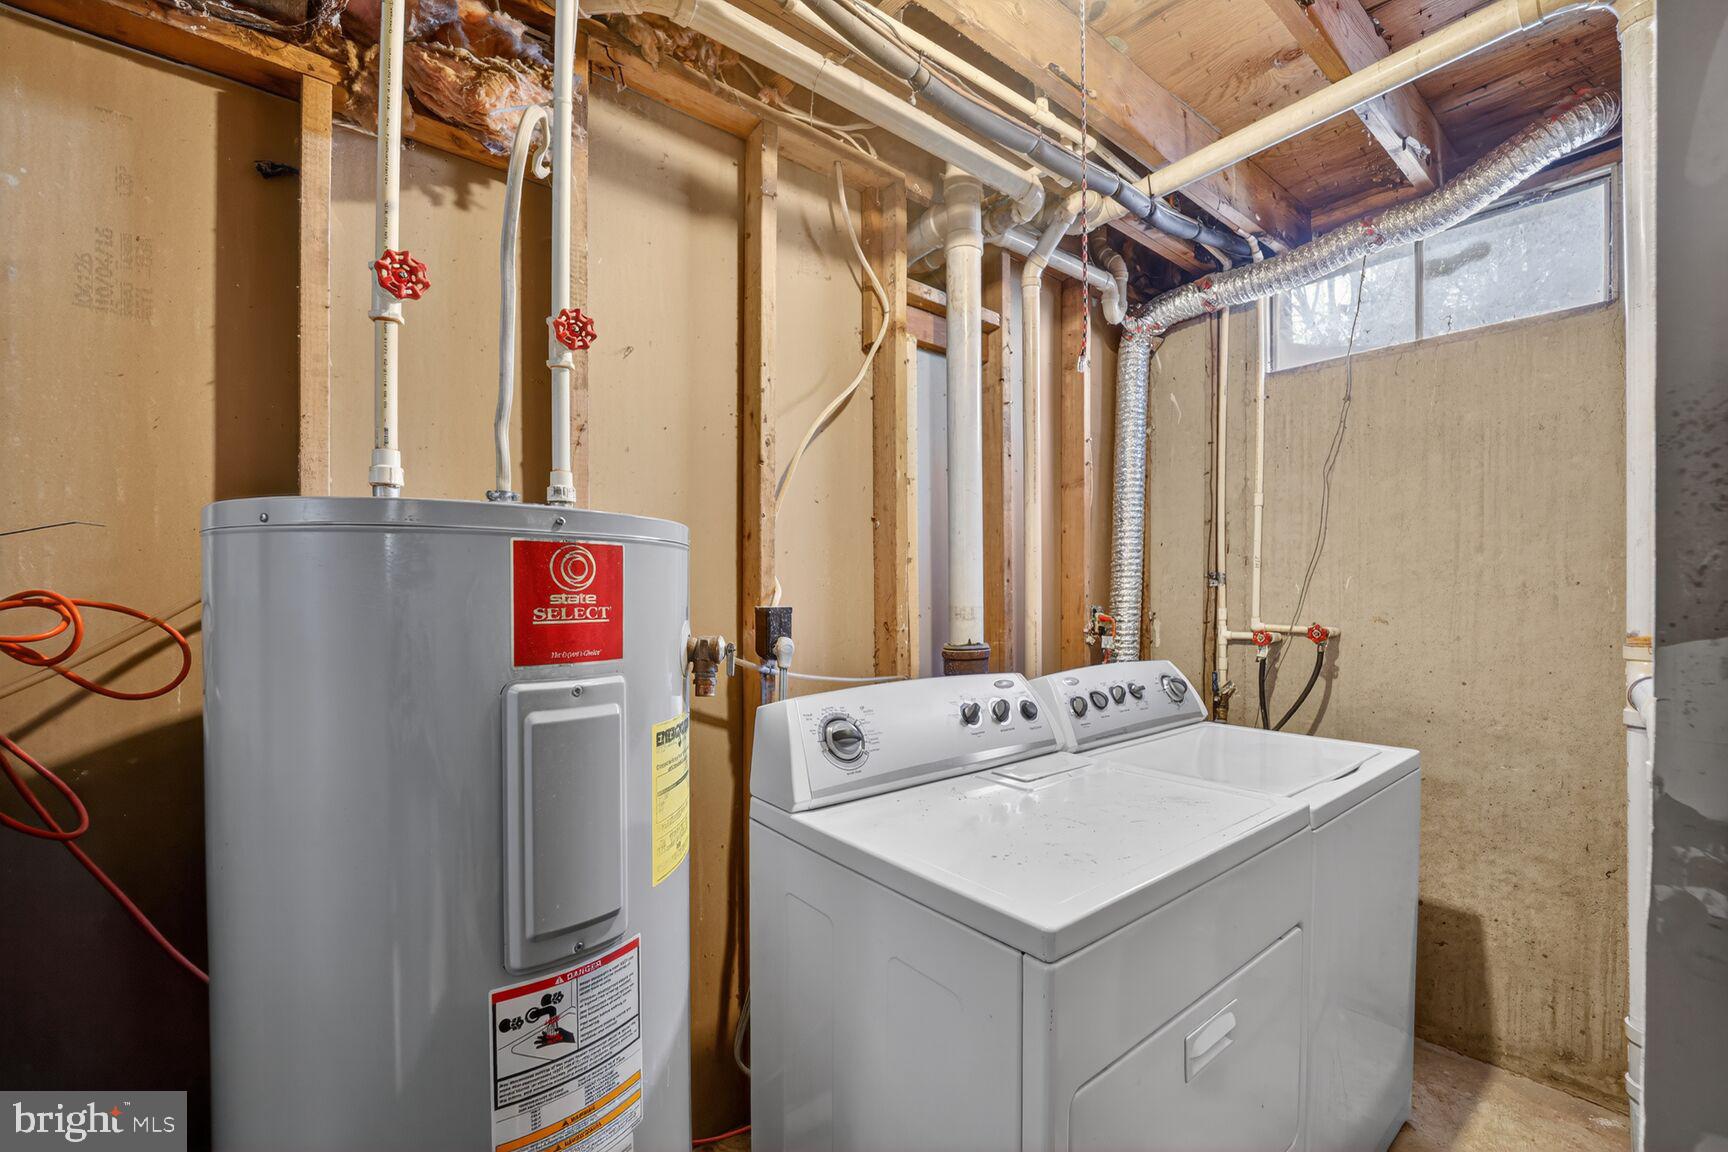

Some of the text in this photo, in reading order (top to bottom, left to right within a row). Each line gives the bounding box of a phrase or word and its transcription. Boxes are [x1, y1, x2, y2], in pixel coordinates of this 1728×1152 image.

[549, 593, 597, 604] state
[533, 606, 610, 621] SELECT
[566, 959, 602, 981] DANGER
